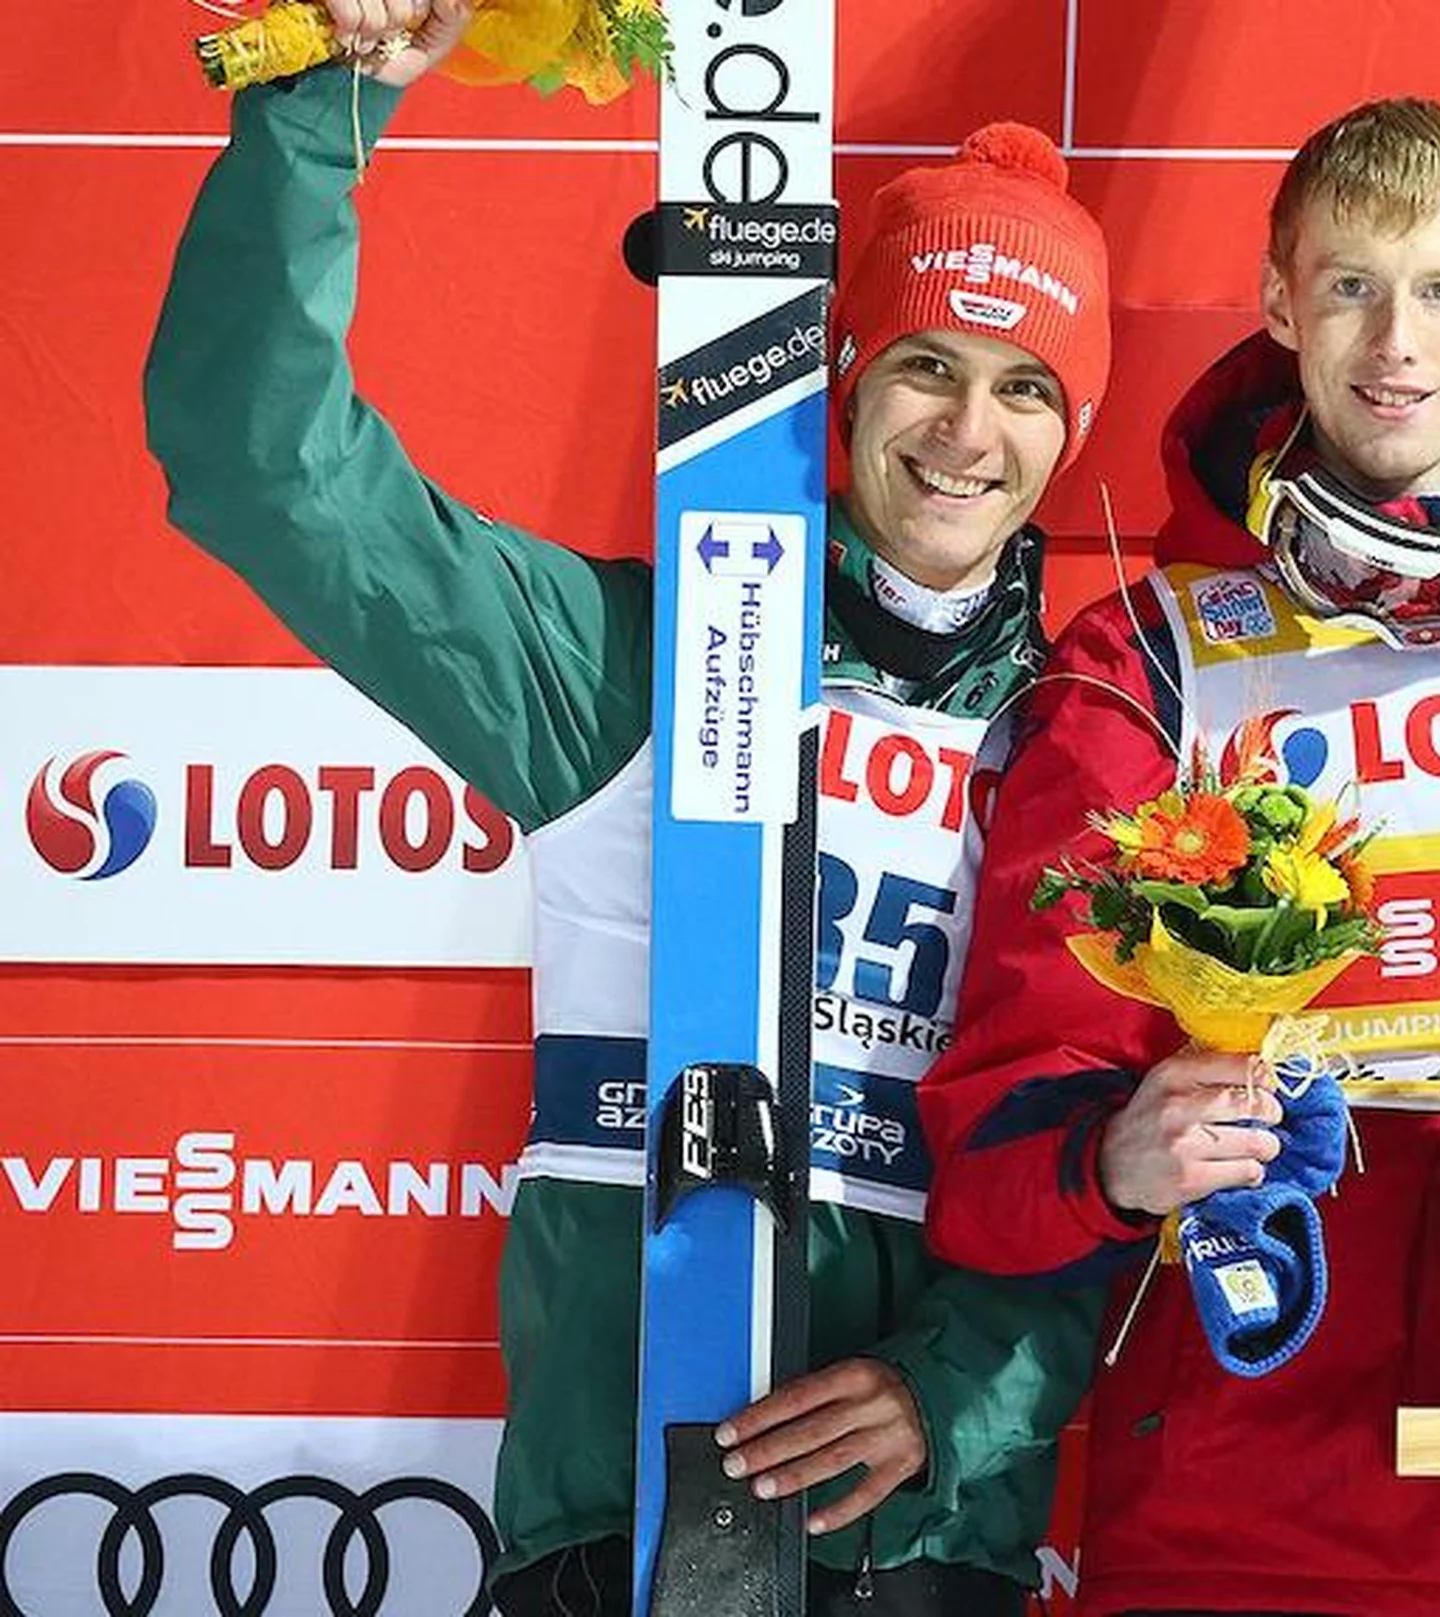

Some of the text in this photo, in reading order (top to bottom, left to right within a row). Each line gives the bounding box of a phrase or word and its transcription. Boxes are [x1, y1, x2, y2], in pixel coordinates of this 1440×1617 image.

[708, 214, 837, 249] fluege.de
[709, 250, 801, 271] ski jumping
[911, 243, 1080, 316] VIESSMANN
[690, 323, 826, 407] fluege.de
[699, 625, 728, 770] Aufzüge
[734, 582, 762, 814] Hübschmann
[184, 763, 515, 875] LOTOS
[820, 709, 973, 834] LOT
[0, 1132, 520, 1250] VIESSMANN
[810, 1127, 905, 1165] ZOTY
